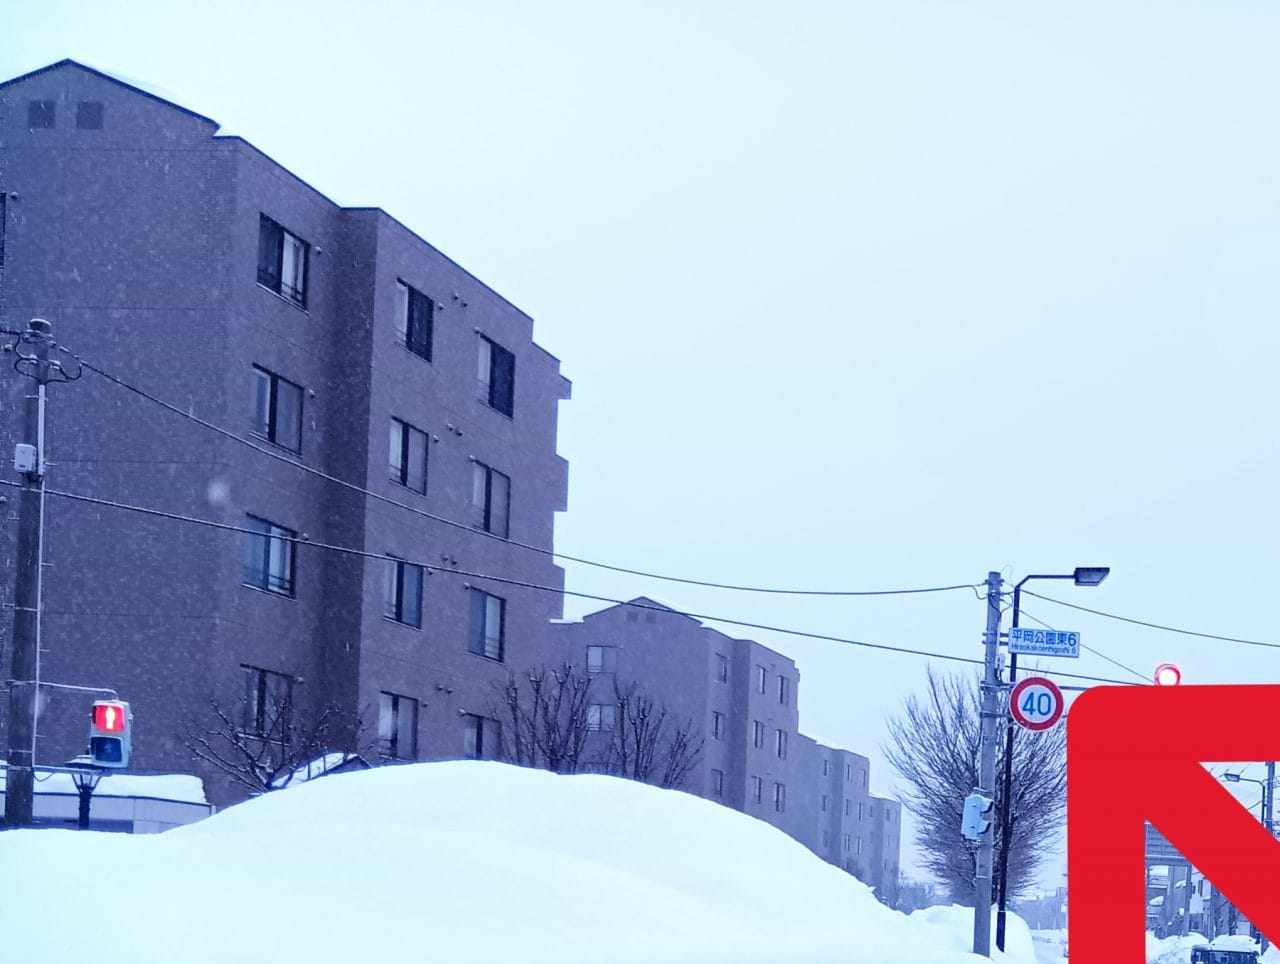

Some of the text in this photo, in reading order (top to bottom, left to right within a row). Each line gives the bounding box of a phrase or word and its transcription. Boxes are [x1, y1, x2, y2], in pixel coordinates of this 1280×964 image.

[1012, 630, 1076, 646] 平岡公園東6
[1022, 692, 1051, 716] 40
